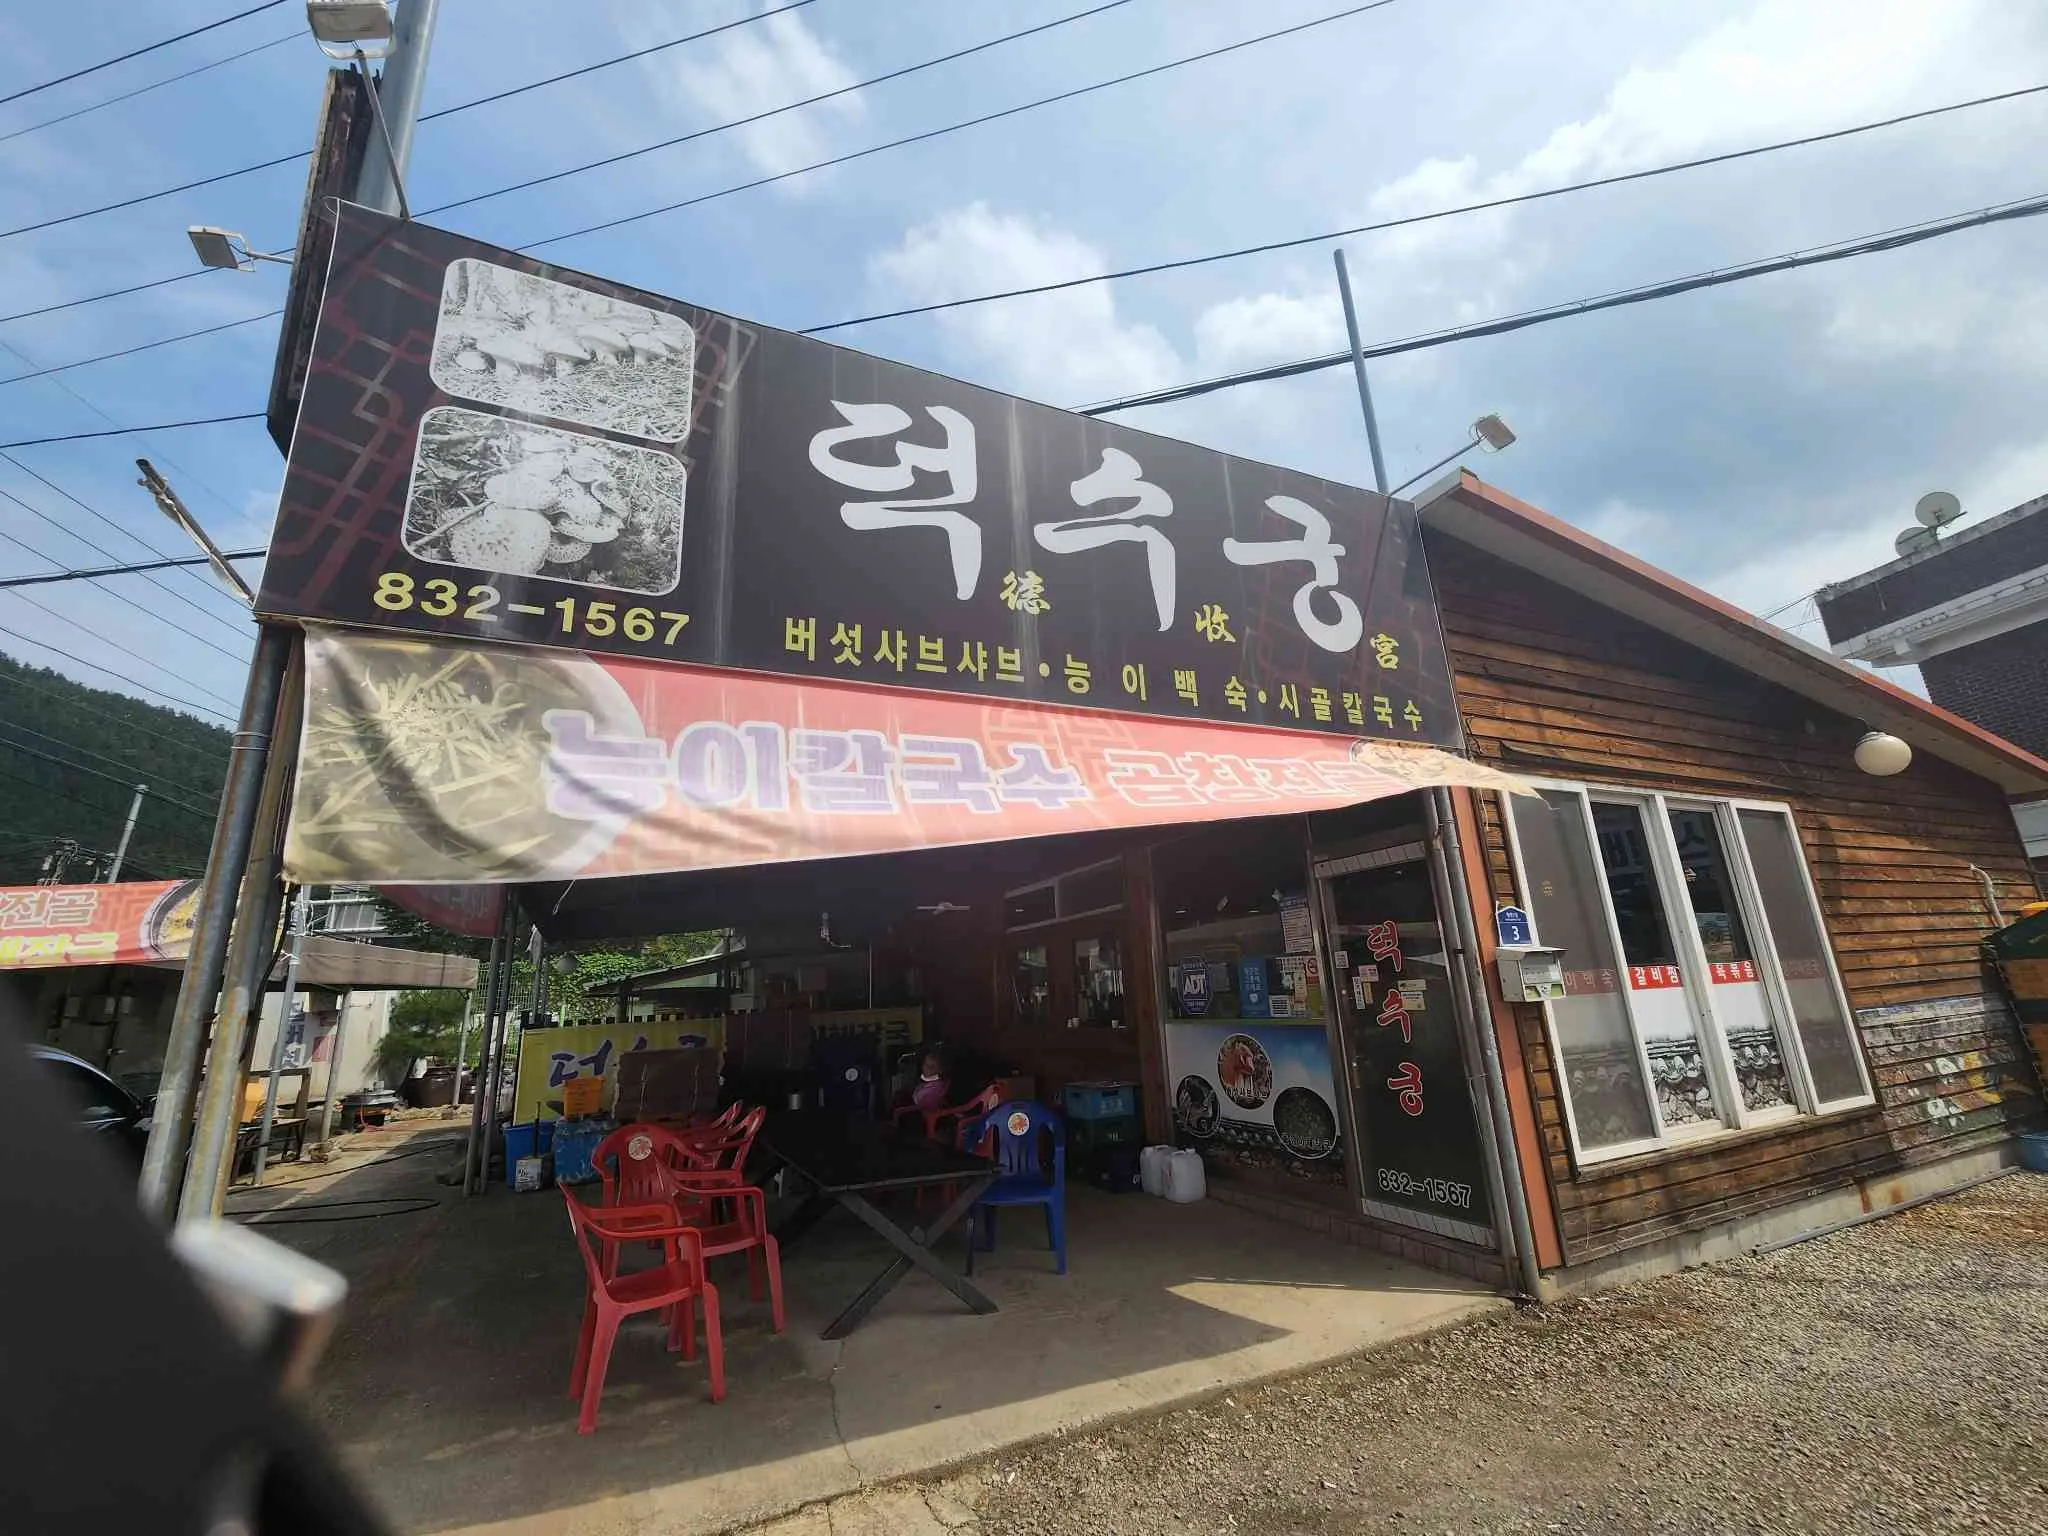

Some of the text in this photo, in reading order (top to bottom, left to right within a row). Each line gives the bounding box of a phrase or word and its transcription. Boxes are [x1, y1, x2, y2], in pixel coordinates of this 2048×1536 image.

[808, 399, 1364, 653] 덕수궁
[373, 572, 690, 646] 832-1567
[541, 709, 1095, 821] 능이칼국수
[1511, 925, 1520, 941] 3
[1633, 966, 1681, 987] 갈비찜
[1366, 920, 1424, 1117] 덕수궁
[1377, 1168, 1473, 1208] 832-1567
